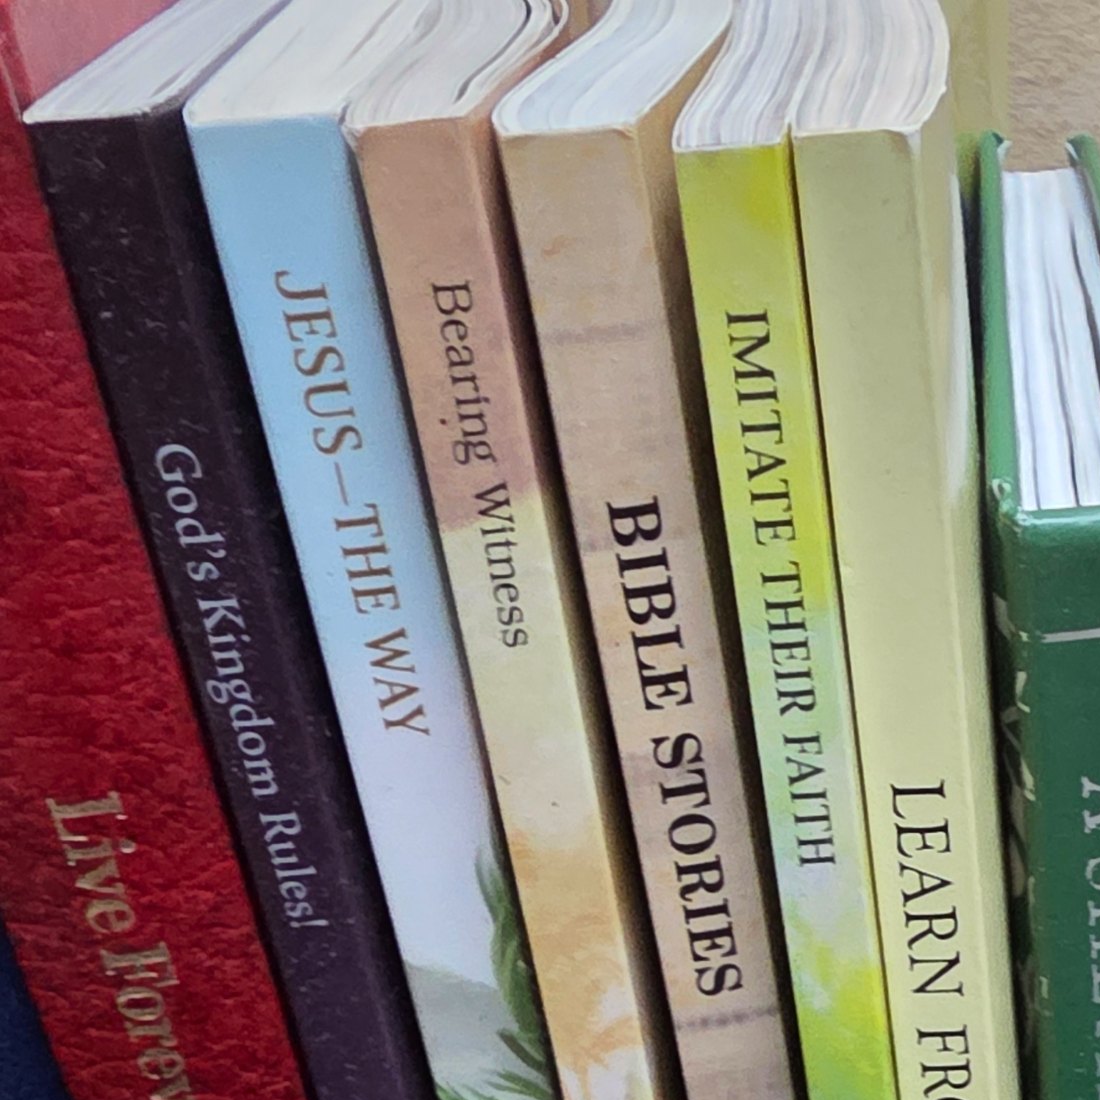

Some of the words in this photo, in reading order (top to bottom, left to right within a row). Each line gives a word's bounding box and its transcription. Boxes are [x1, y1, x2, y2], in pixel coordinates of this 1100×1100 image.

[430, 280, 497, 467] Bearing
[473, 480, 529, 649] Witness
[724, 310, 798, 546] IMITATE
[363, 626, 430, 738] WAY
[606, 496, 694, 711] BIBLE
[651, 732, 744, 998] STORIES
[759, 561, 817, 716] THEIR
[46, 790, 137, 934] Live
[198, 597, 281, 799] Kingdom
[259, 812, 329, 928] Rules!
[782, 731, 836, 867] FAITH
[889, 779, 965, 997] LEARN
